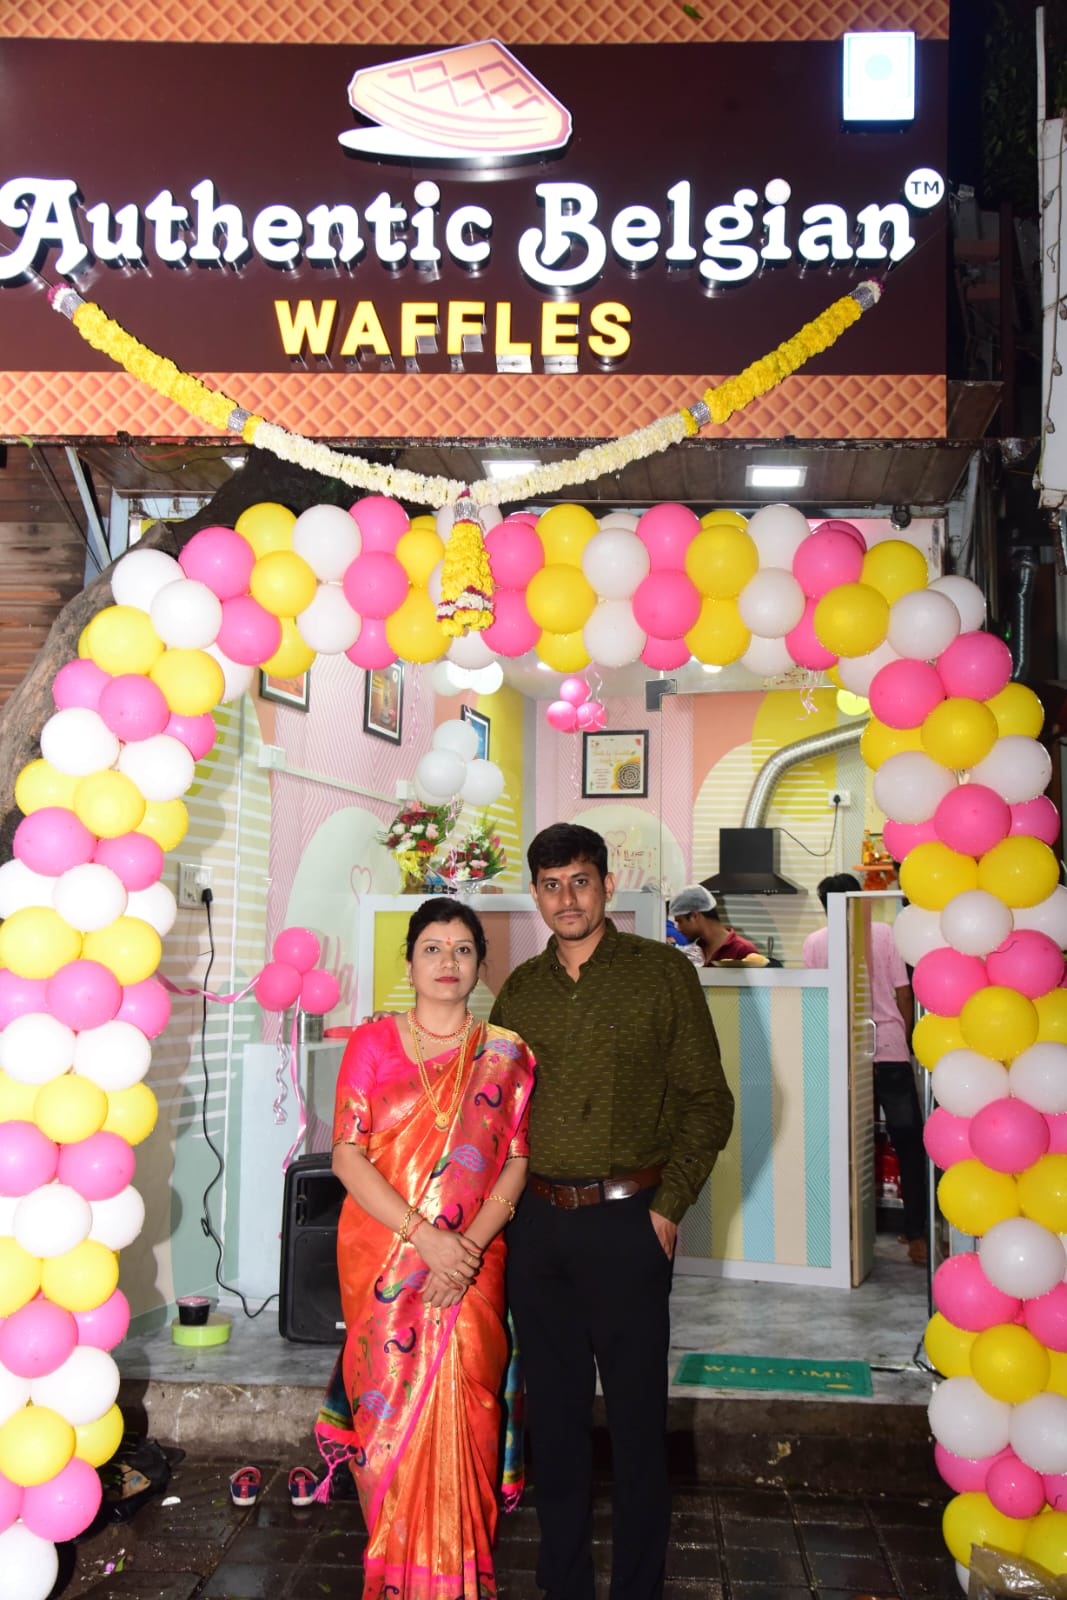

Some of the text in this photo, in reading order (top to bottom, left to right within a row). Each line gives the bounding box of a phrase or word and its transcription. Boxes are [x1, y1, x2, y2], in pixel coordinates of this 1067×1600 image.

[0, 178, 493, 280] Authentic
[519, 179, 915, 287] Belgian
[275, 299, 632, 358] WAFFLES
